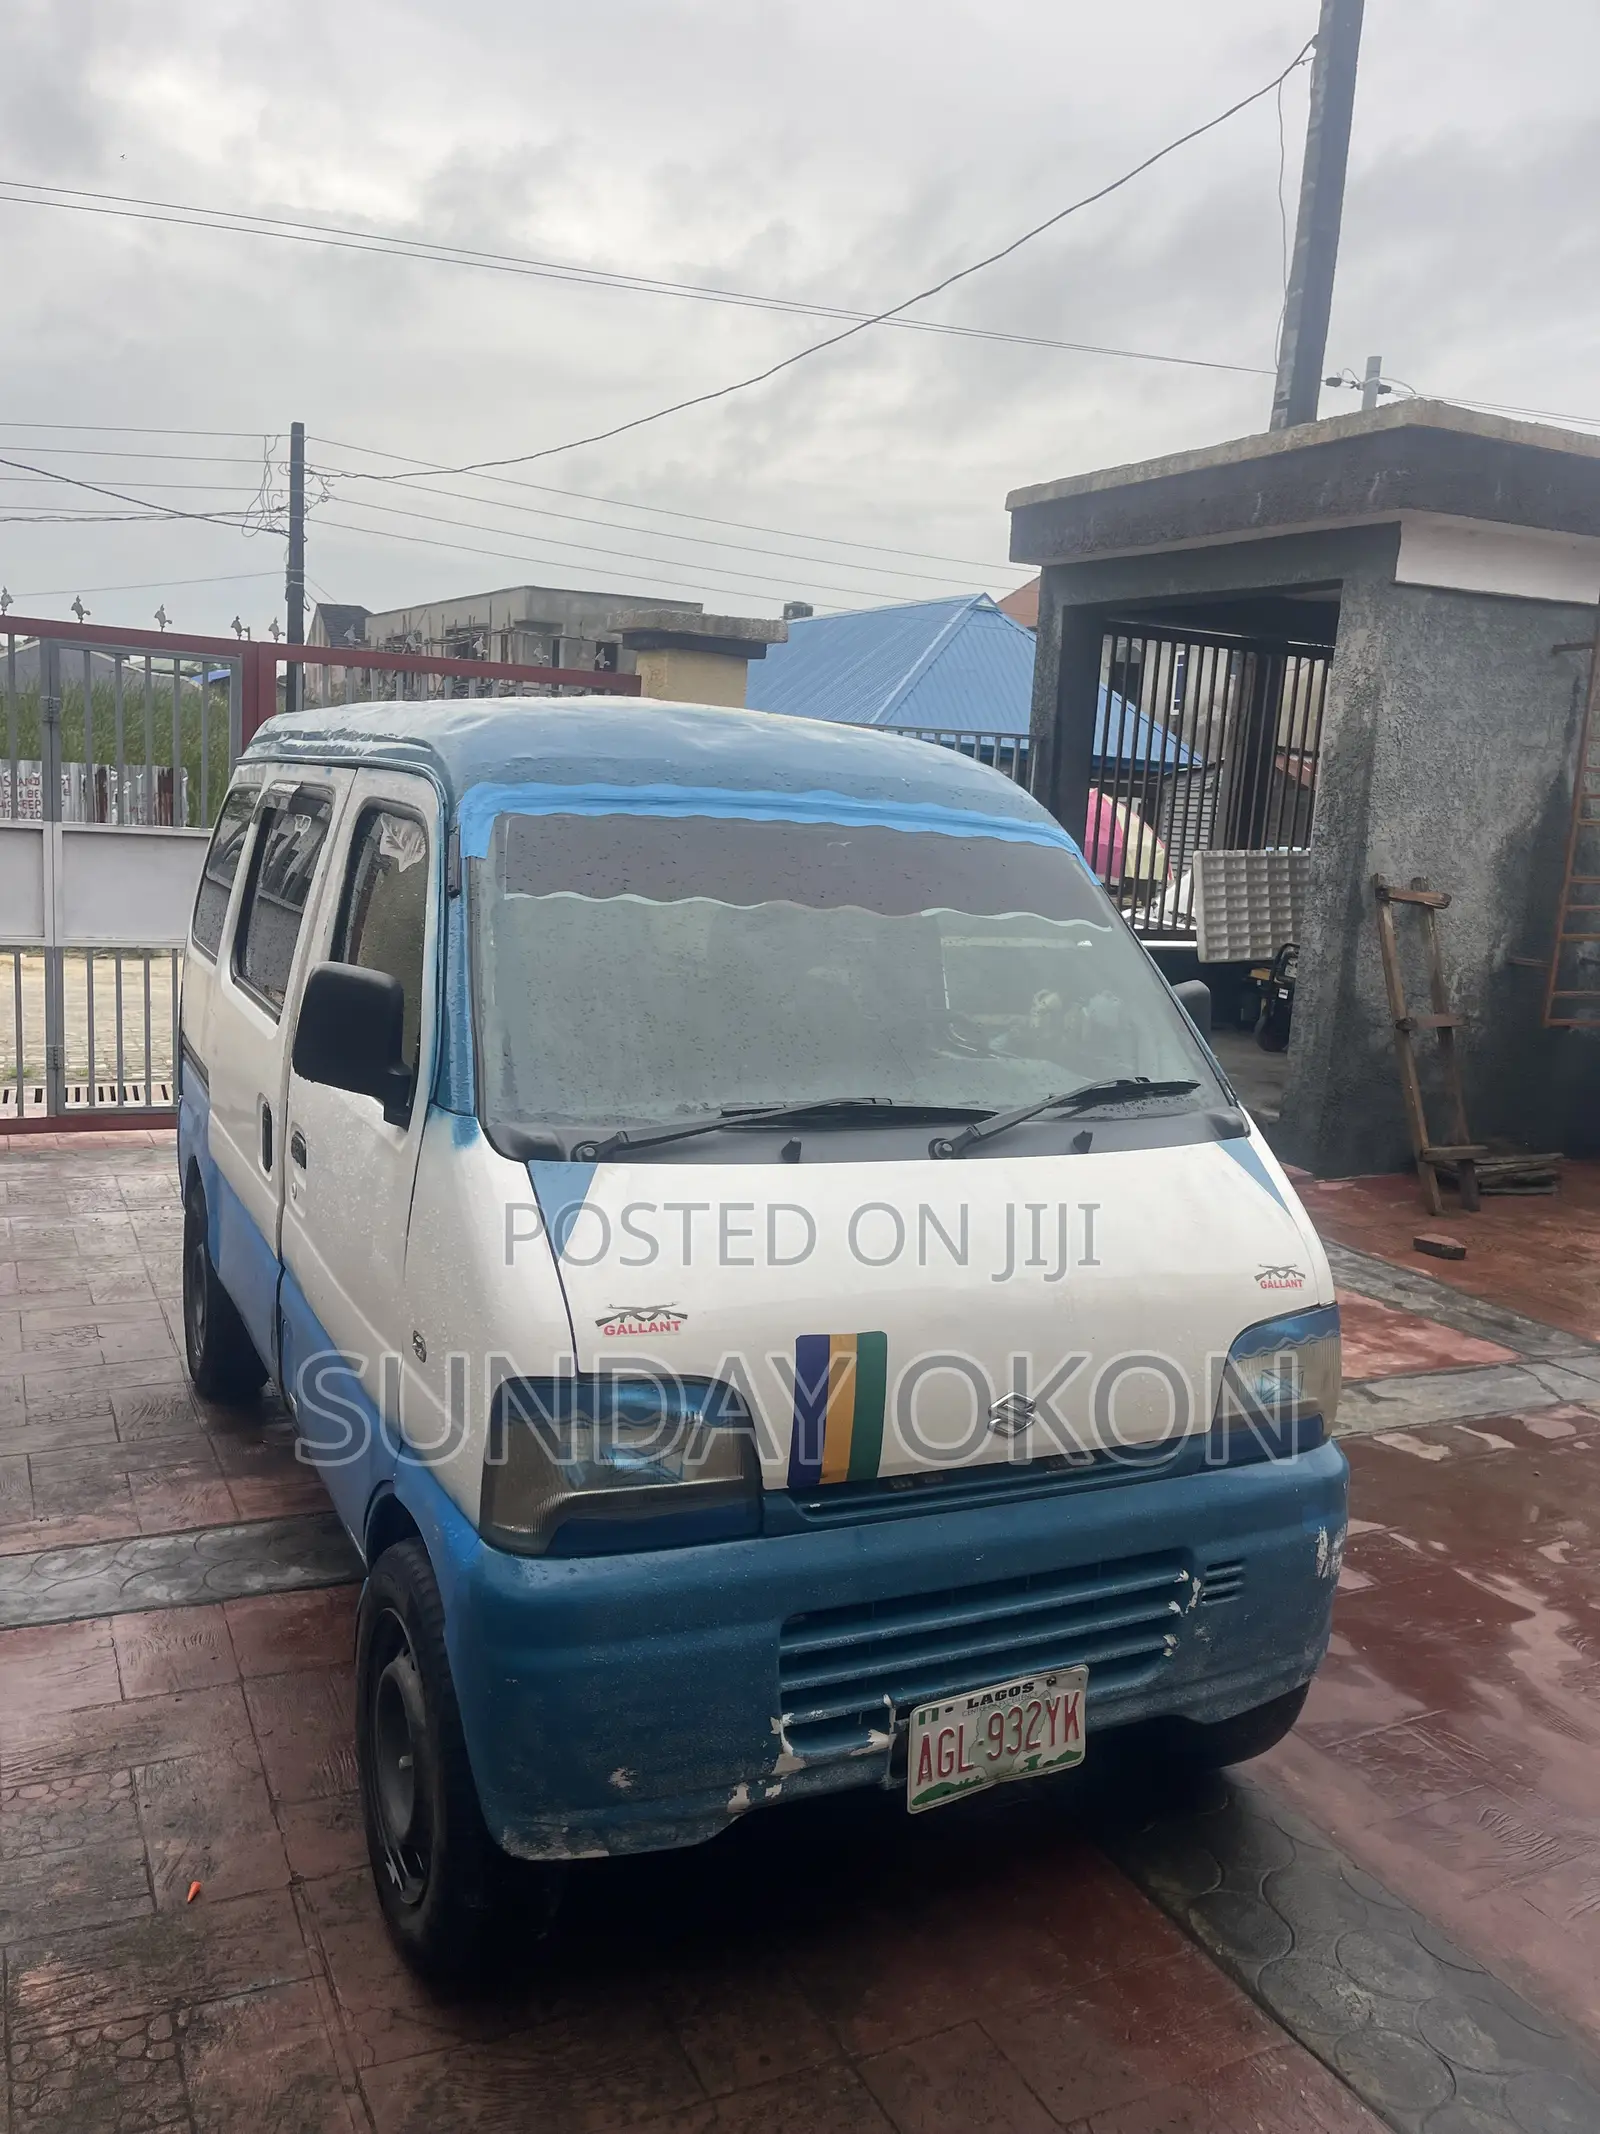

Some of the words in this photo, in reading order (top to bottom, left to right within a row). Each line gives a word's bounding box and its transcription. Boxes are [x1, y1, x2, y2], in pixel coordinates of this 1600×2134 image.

[1260, 1279, 1303, 1290] GALLANT
[603, 1320, 682, 1336] GALLANT
[967, 1681, 1035, 1710] LAGOS
